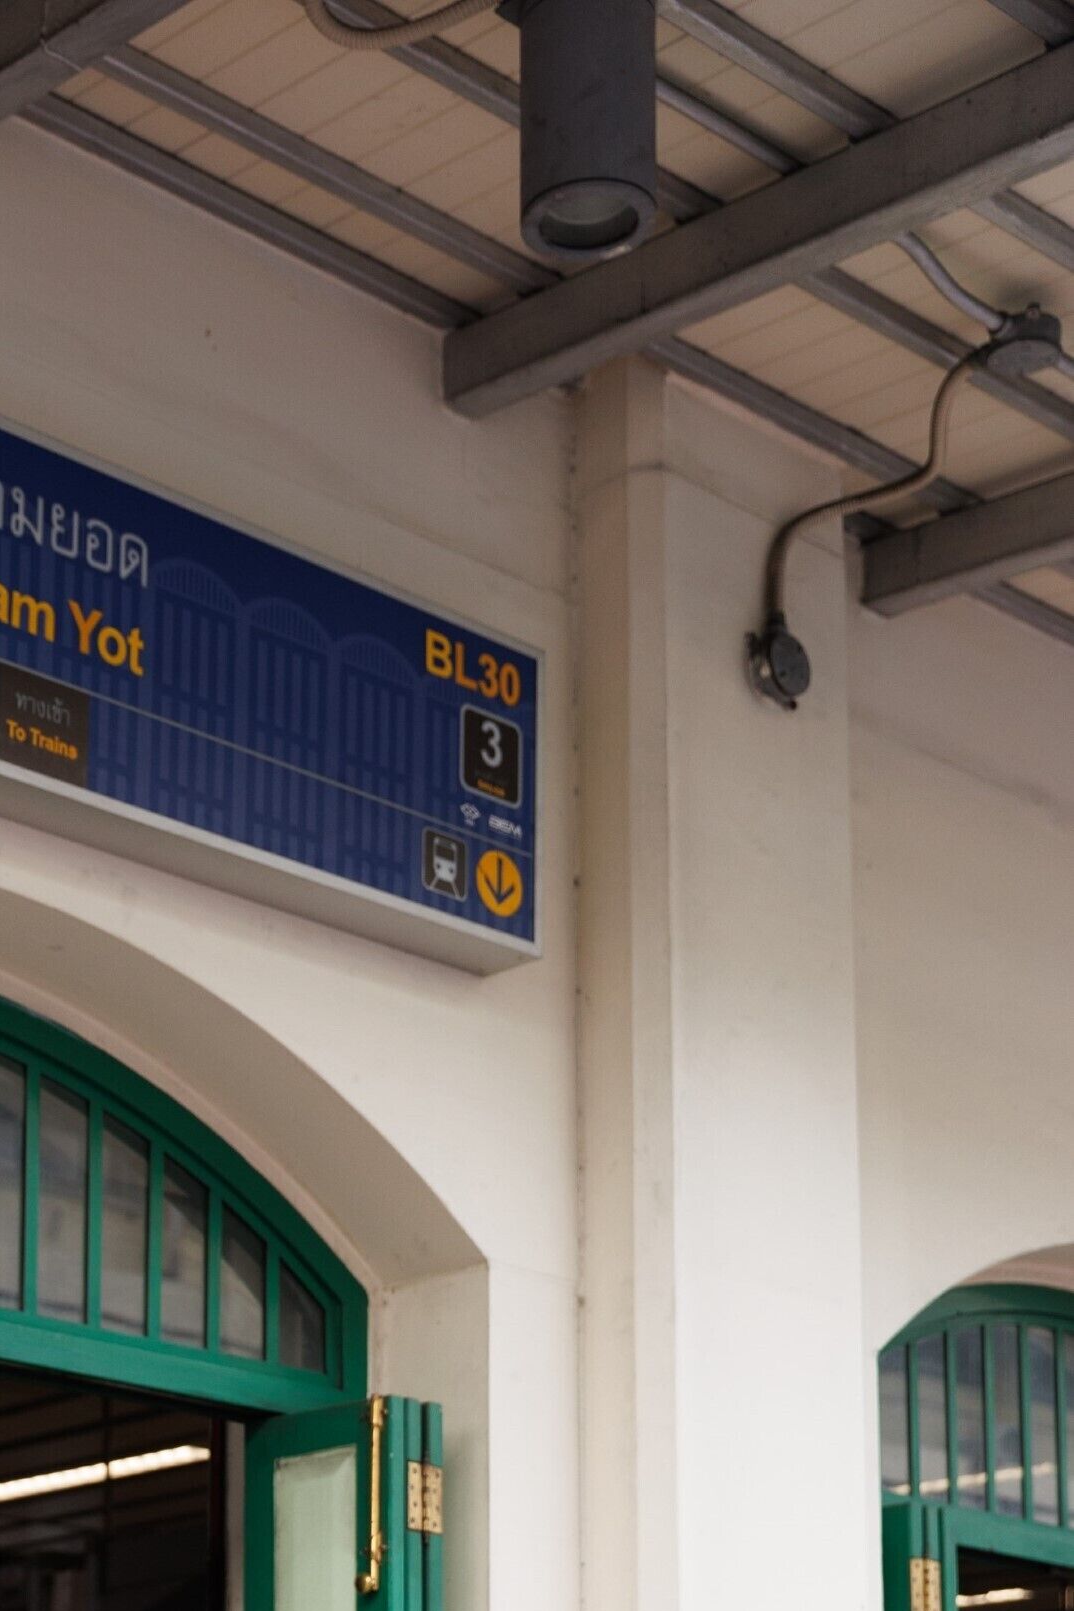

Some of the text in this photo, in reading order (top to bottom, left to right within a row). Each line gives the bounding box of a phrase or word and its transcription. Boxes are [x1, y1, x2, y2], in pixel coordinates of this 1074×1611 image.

[68, 599, 145, 678] Yot
[425, 627, 522, 708] BL30
[5, 718, 79, 761] To Trains
[479, 720, 503, 768] 3
